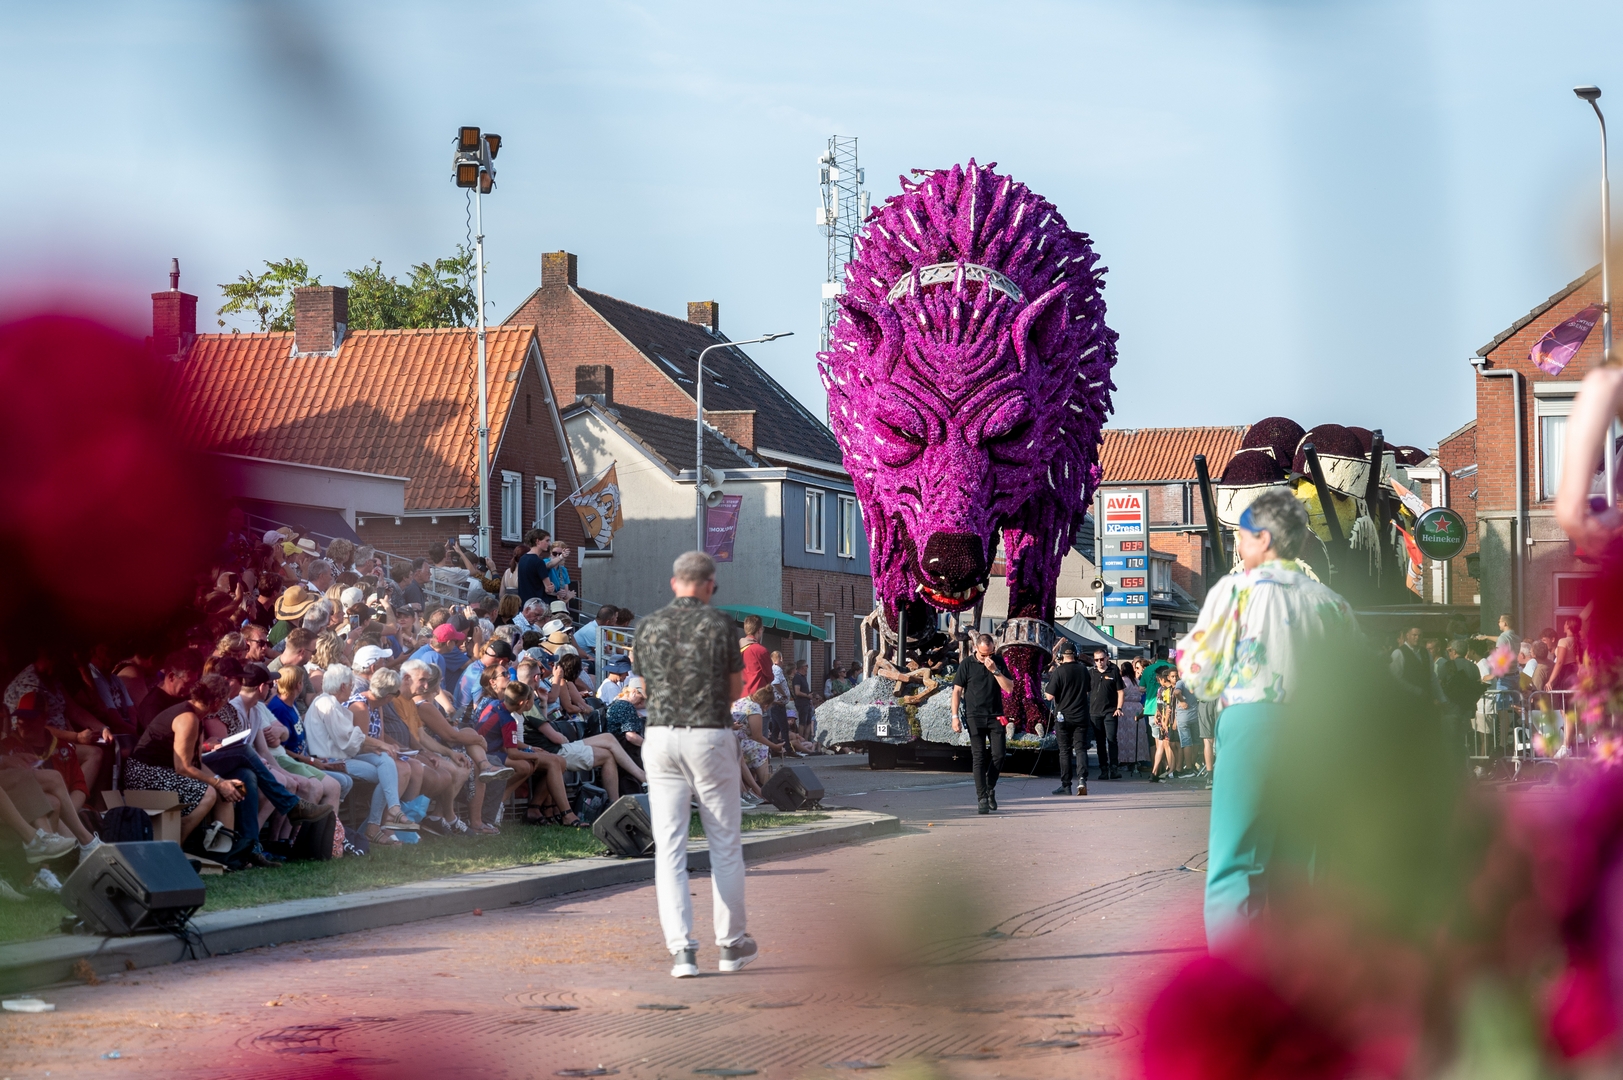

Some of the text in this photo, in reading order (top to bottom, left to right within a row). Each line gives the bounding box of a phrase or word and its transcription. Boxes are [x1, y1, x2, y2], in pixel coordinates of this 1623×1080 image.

[1107, 495, 1141, 509] AVIA
[1107, 524, 1140, 532] XPress
[1422, 534, 1460, 543] Heineken
[1067, 598, 1096, 616] Pri
